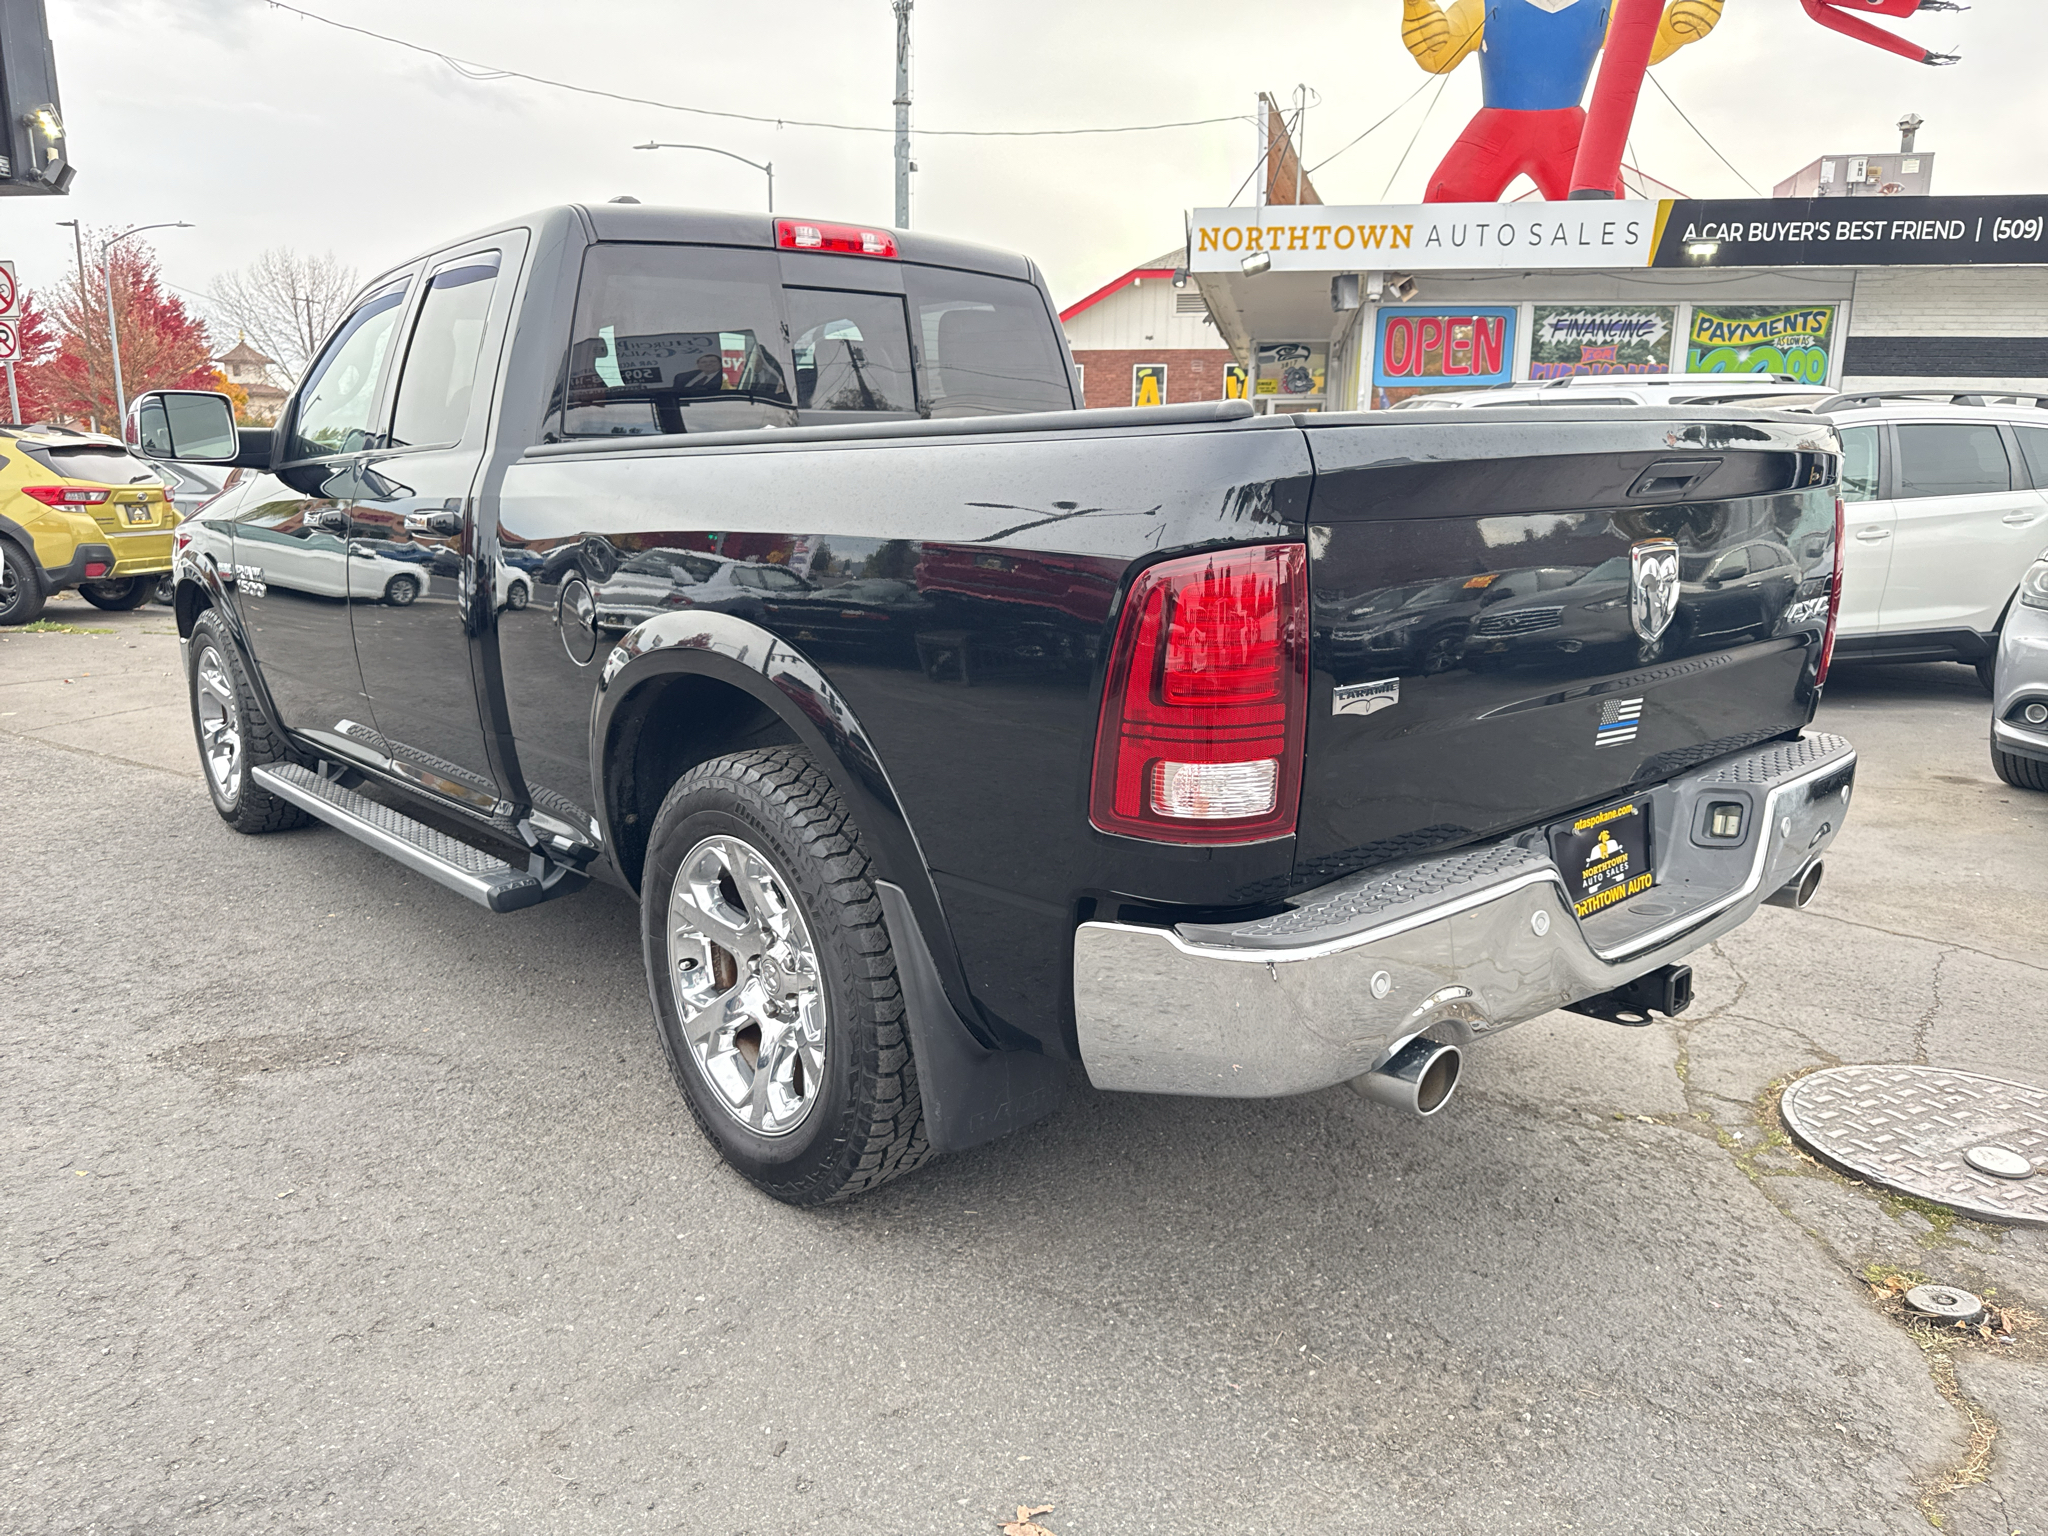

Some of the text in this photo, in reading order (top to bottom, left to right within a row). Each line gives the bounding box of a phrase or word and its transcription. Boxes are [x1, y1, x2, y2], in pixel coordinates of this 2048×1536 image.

[1198, 221, 1640, 252] NORTHTOWN AUTO SALES
[1682, 222, 1698, 242] A
[1702, 222, 1744, 242] CAR
[1748, 221, 1832, 242] BUYER'S
[1835, 220, 1888, 241] BEST
[1890, 219, 1966, 240] FRIEND
[1992, 215, 2044, 242] (509)
[1550, 318, 1655, 339] FINANCING
[1696, 310, 1828, 342] PAYMENTS
[1384, 316, 1505, 376] OPEN
[1584, 348, 1613, 361] FOR
[1775, 336, 1811, 347] AS LOW AS
[1574, 804, 1633, 830] ntaspokane.com
[1581, 852, 1629, 879] NORTHTOWN
[1582, 861, 1630, 888] AUTO SALES
[1627, 872, 1653, 896] AUTO
